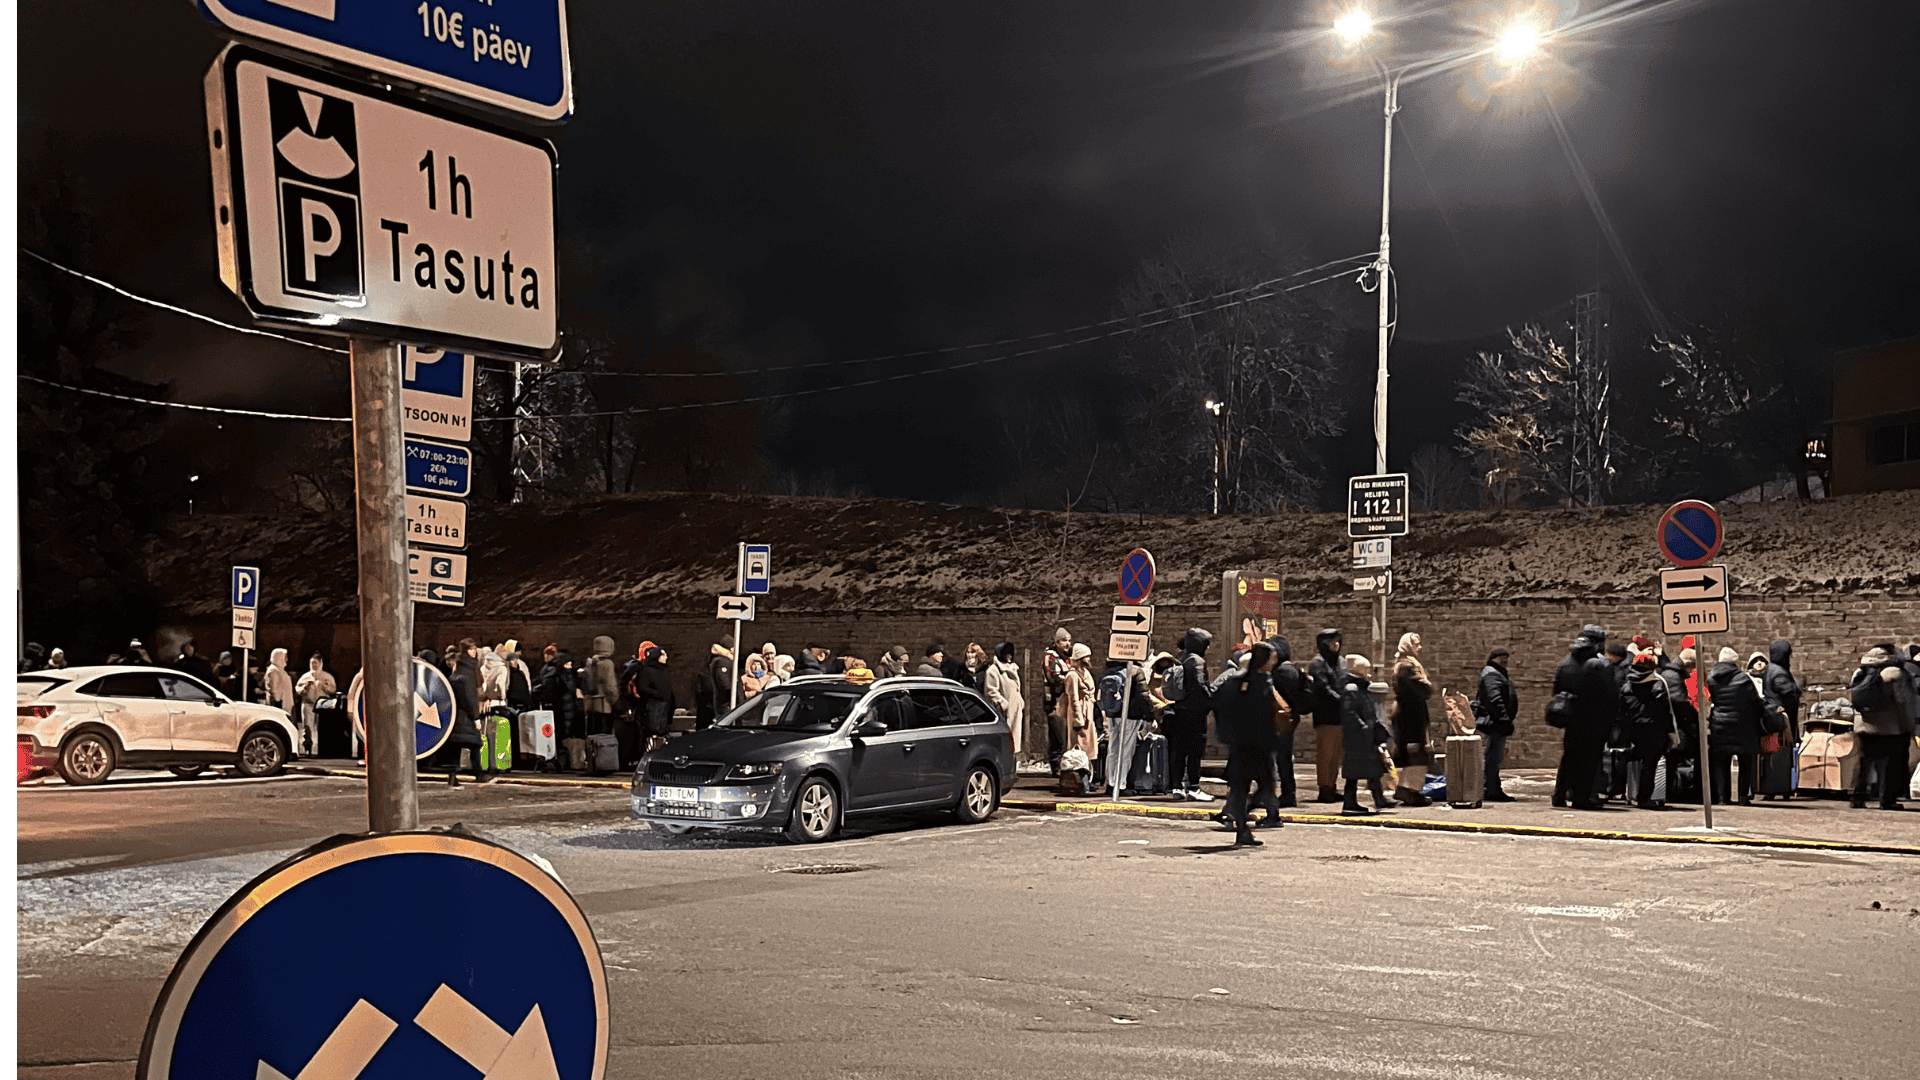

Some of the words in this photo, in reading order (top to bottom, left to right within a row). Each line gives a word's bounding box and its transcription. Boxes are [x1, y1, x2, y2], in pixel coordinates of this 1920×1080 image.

[417, 1, 465, 49] 10€
[472, 23, 531, 69] päev
[418, 149, 473, 219] 1h
[301, 197, 342, 282] P
[380, 218, 540, 310] Tasuta
[452, 414, 466, 427] N1
[420, 449, 469, 466] 07:00-23:00
[423, 473, 438, 484] 10€
[438, 477, 458, 487] päev
[418, 504, 436, 519] 1h
[1363, 498, 1390, 515] 112
[407, 518, 459, 538] Tasuta
[1358, 543, 1373, 555] WC
[238, 572, 252, 603] P
[1672, 611, 1680, 625] 5
[1688, 610, 1717, 624] min
[677, 788, 695, 799] TLM
